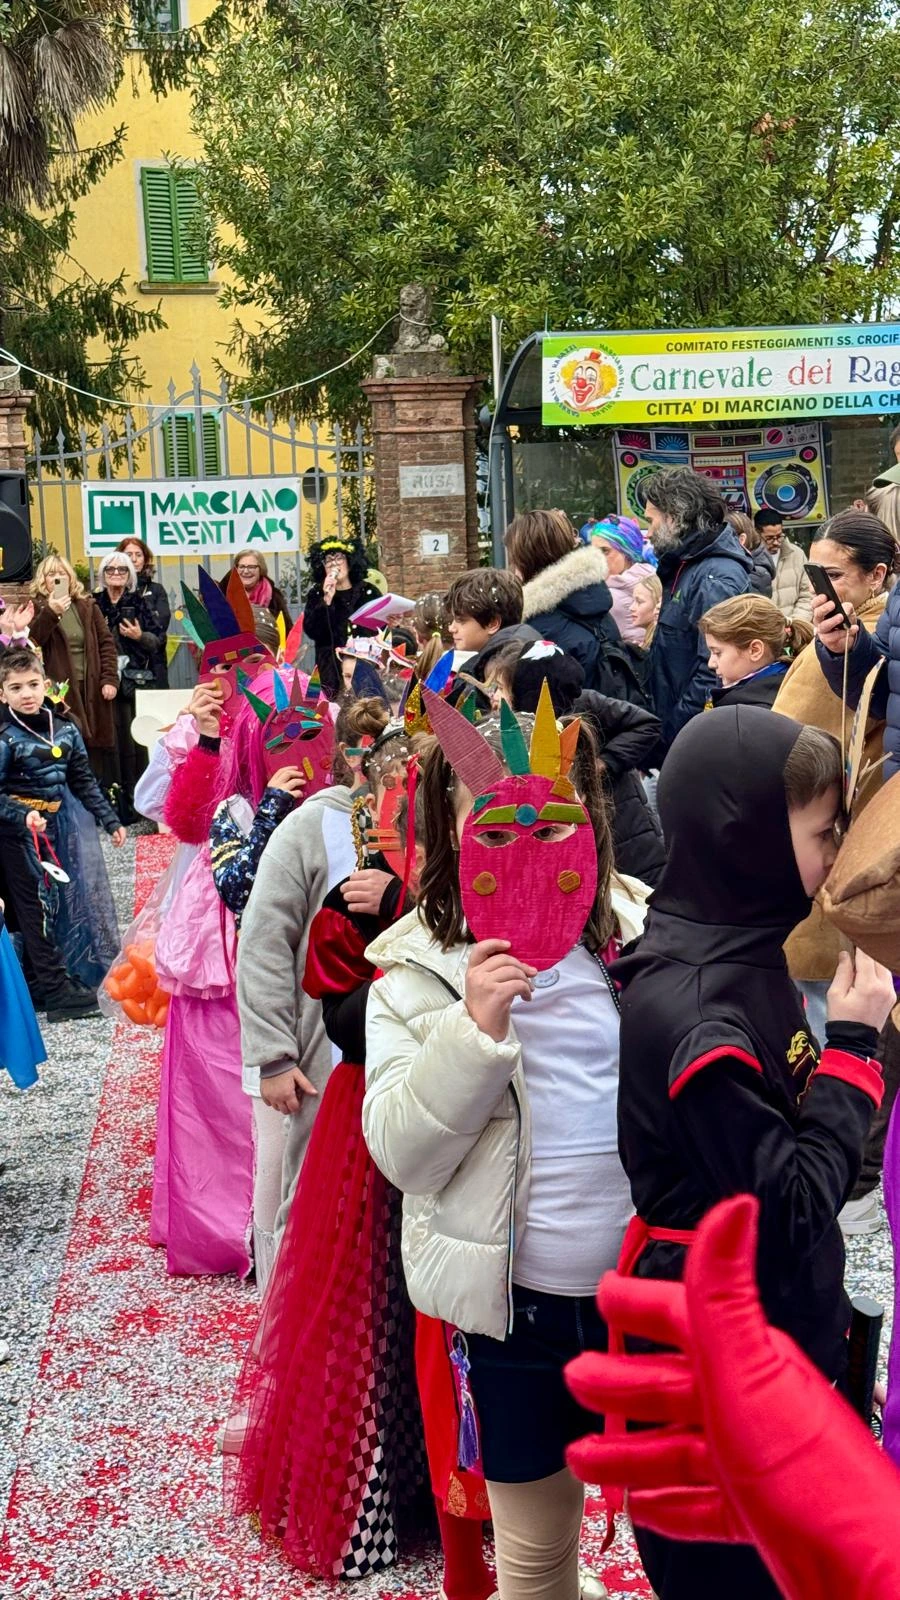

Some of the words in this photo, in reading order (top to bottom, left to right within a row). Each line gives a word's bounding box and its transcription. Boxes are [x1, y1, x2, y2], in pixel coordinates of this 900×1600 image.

[666, 340, 728, 352] COMITATO
[732, 336, 833, 350] FESTEGGIAMENTI
[837, 335, 854, 346] SS.
[630, 355, 772, 391] Carnevale
[788, 353, 832, 386] dei
[646, 400, 697, 416] CITTA'
[702, 400, 719, 414] DI
[725, 397, 818, 413] MARCIANO
[822, 394, 873, 410] DELLA
[150, 487, 298, 516] MARCIANO
[159, 519, 235, 545] EVENTI
[246, 517, 294, 543] APS
[432, 538, 440, 552] 2
